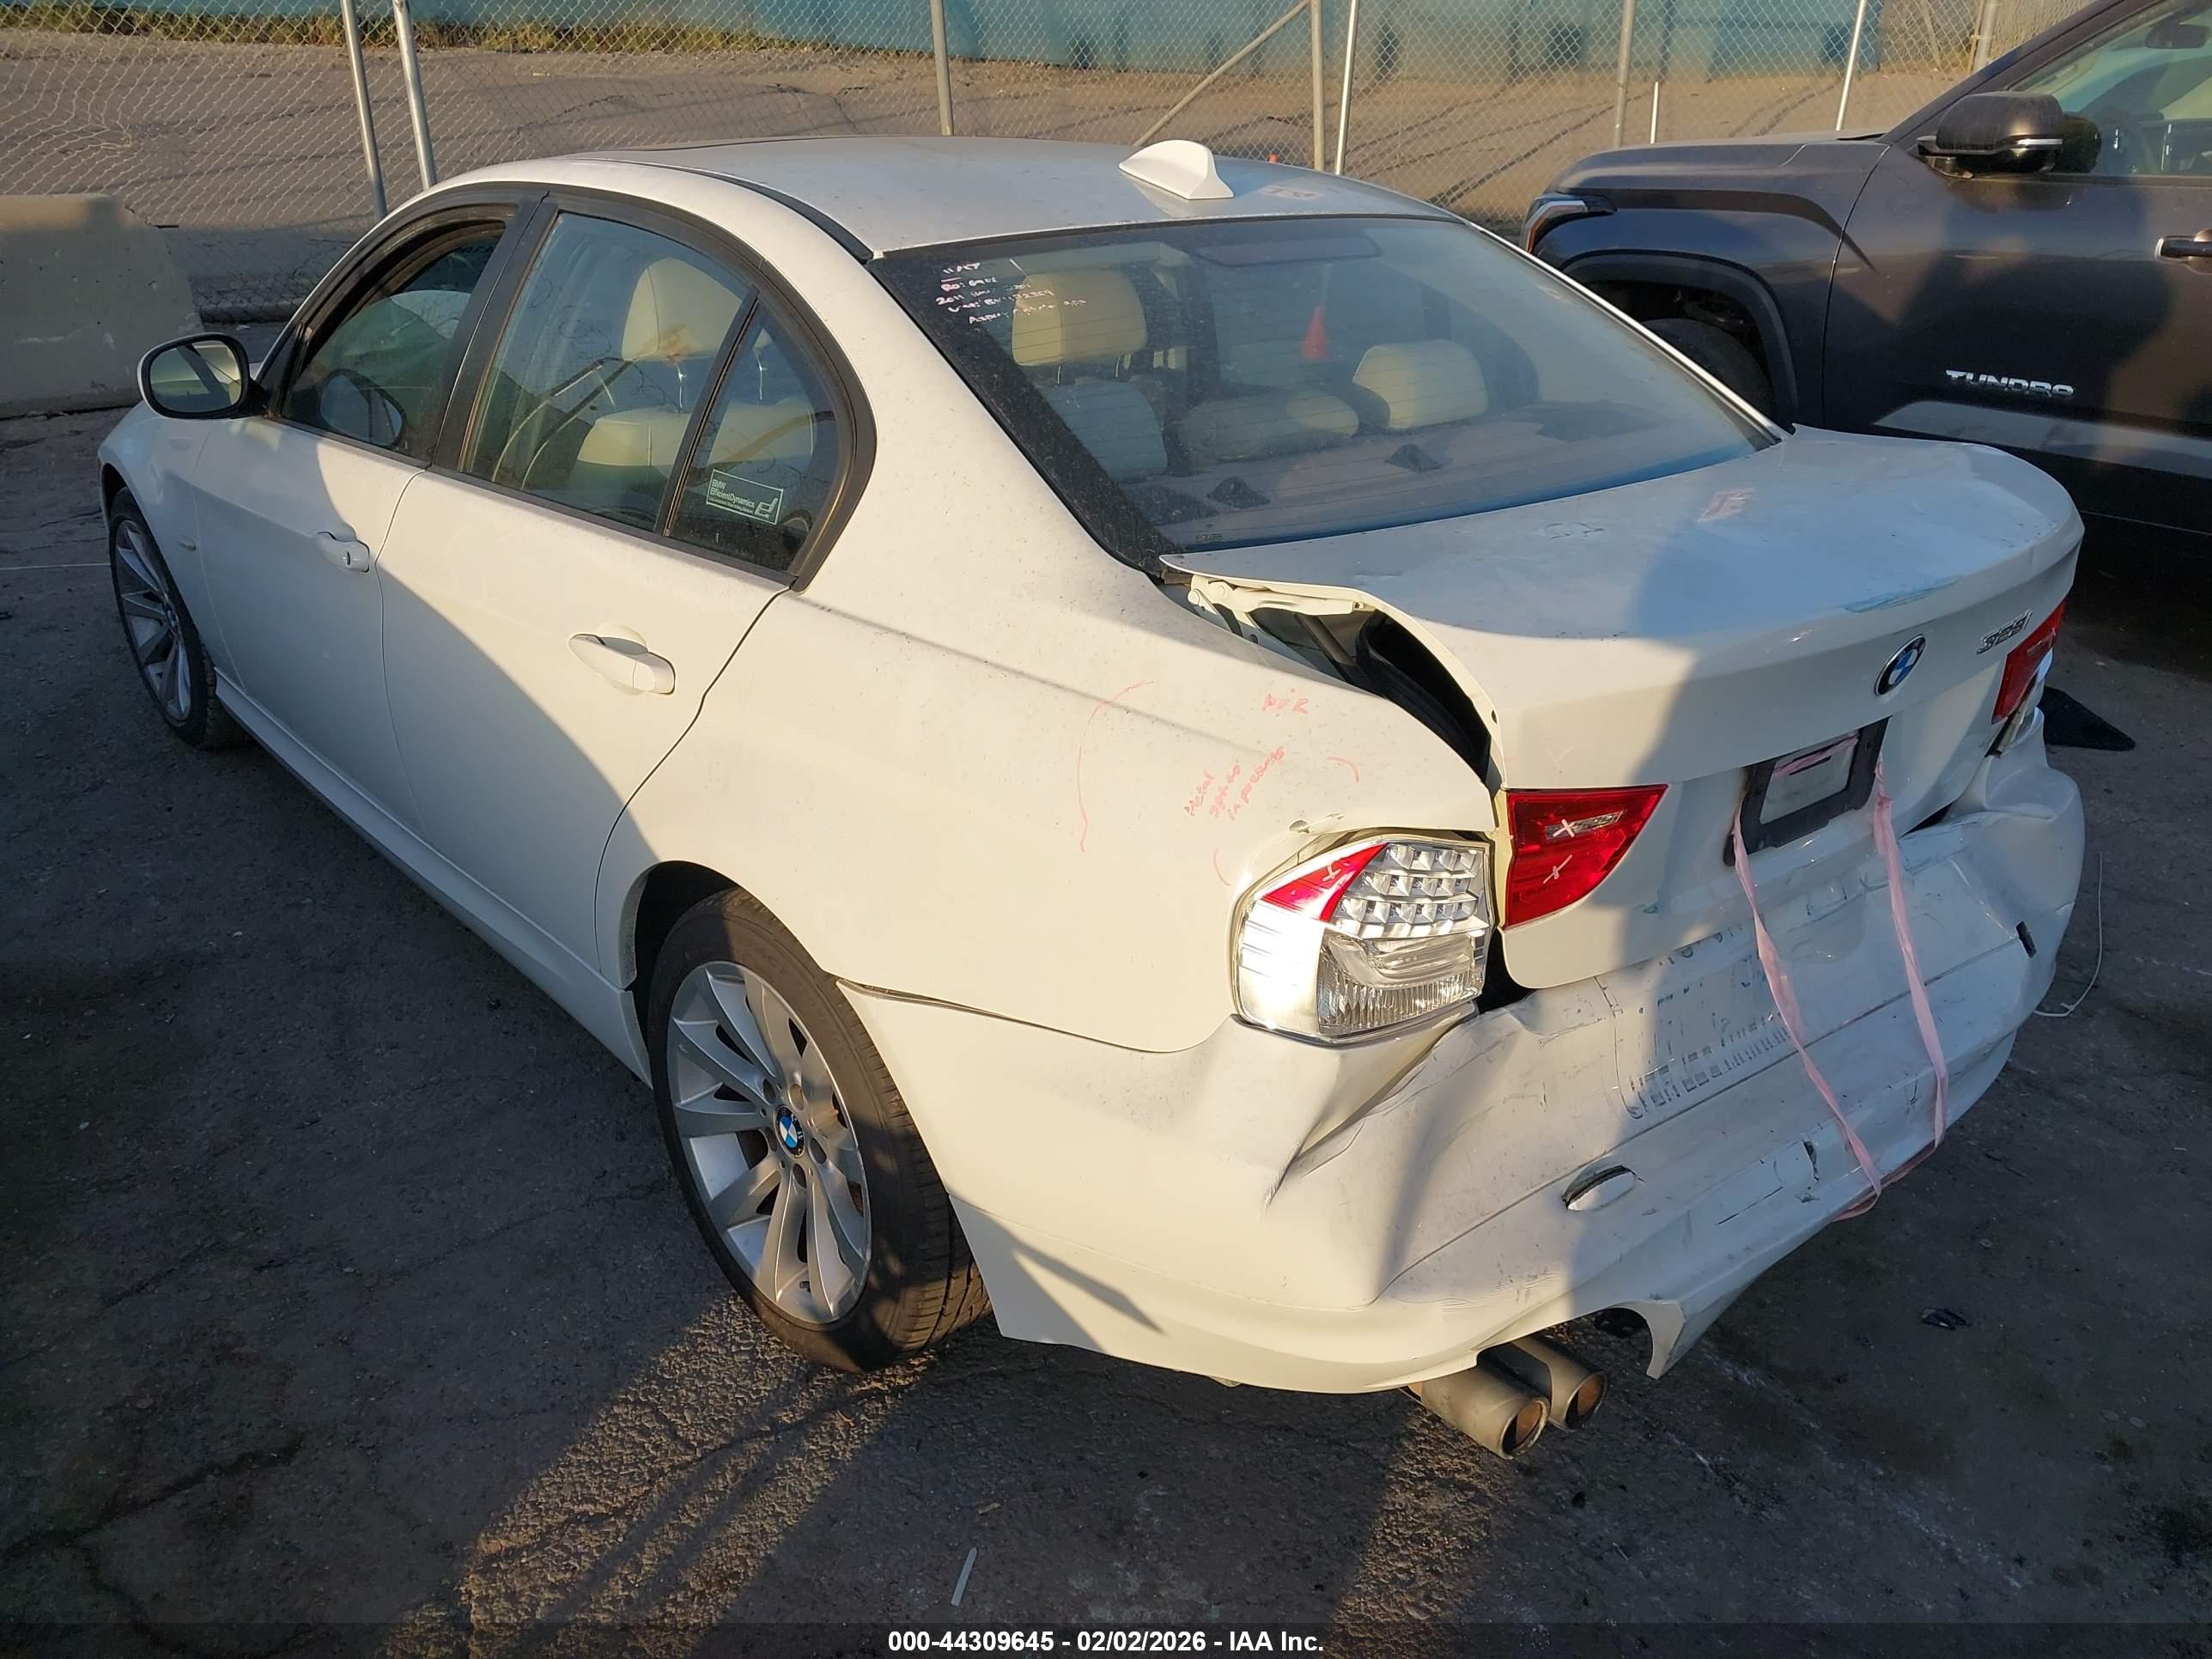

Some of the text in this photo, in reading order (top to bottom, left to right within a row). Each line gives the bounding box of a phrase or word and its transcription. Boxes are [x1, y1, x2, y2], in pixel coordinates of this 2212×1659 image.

[935, 294, 965, 306] 2011
[1945, 369, 2075, 397] TUNDRA
[712, 479, 726, 490] BMW
